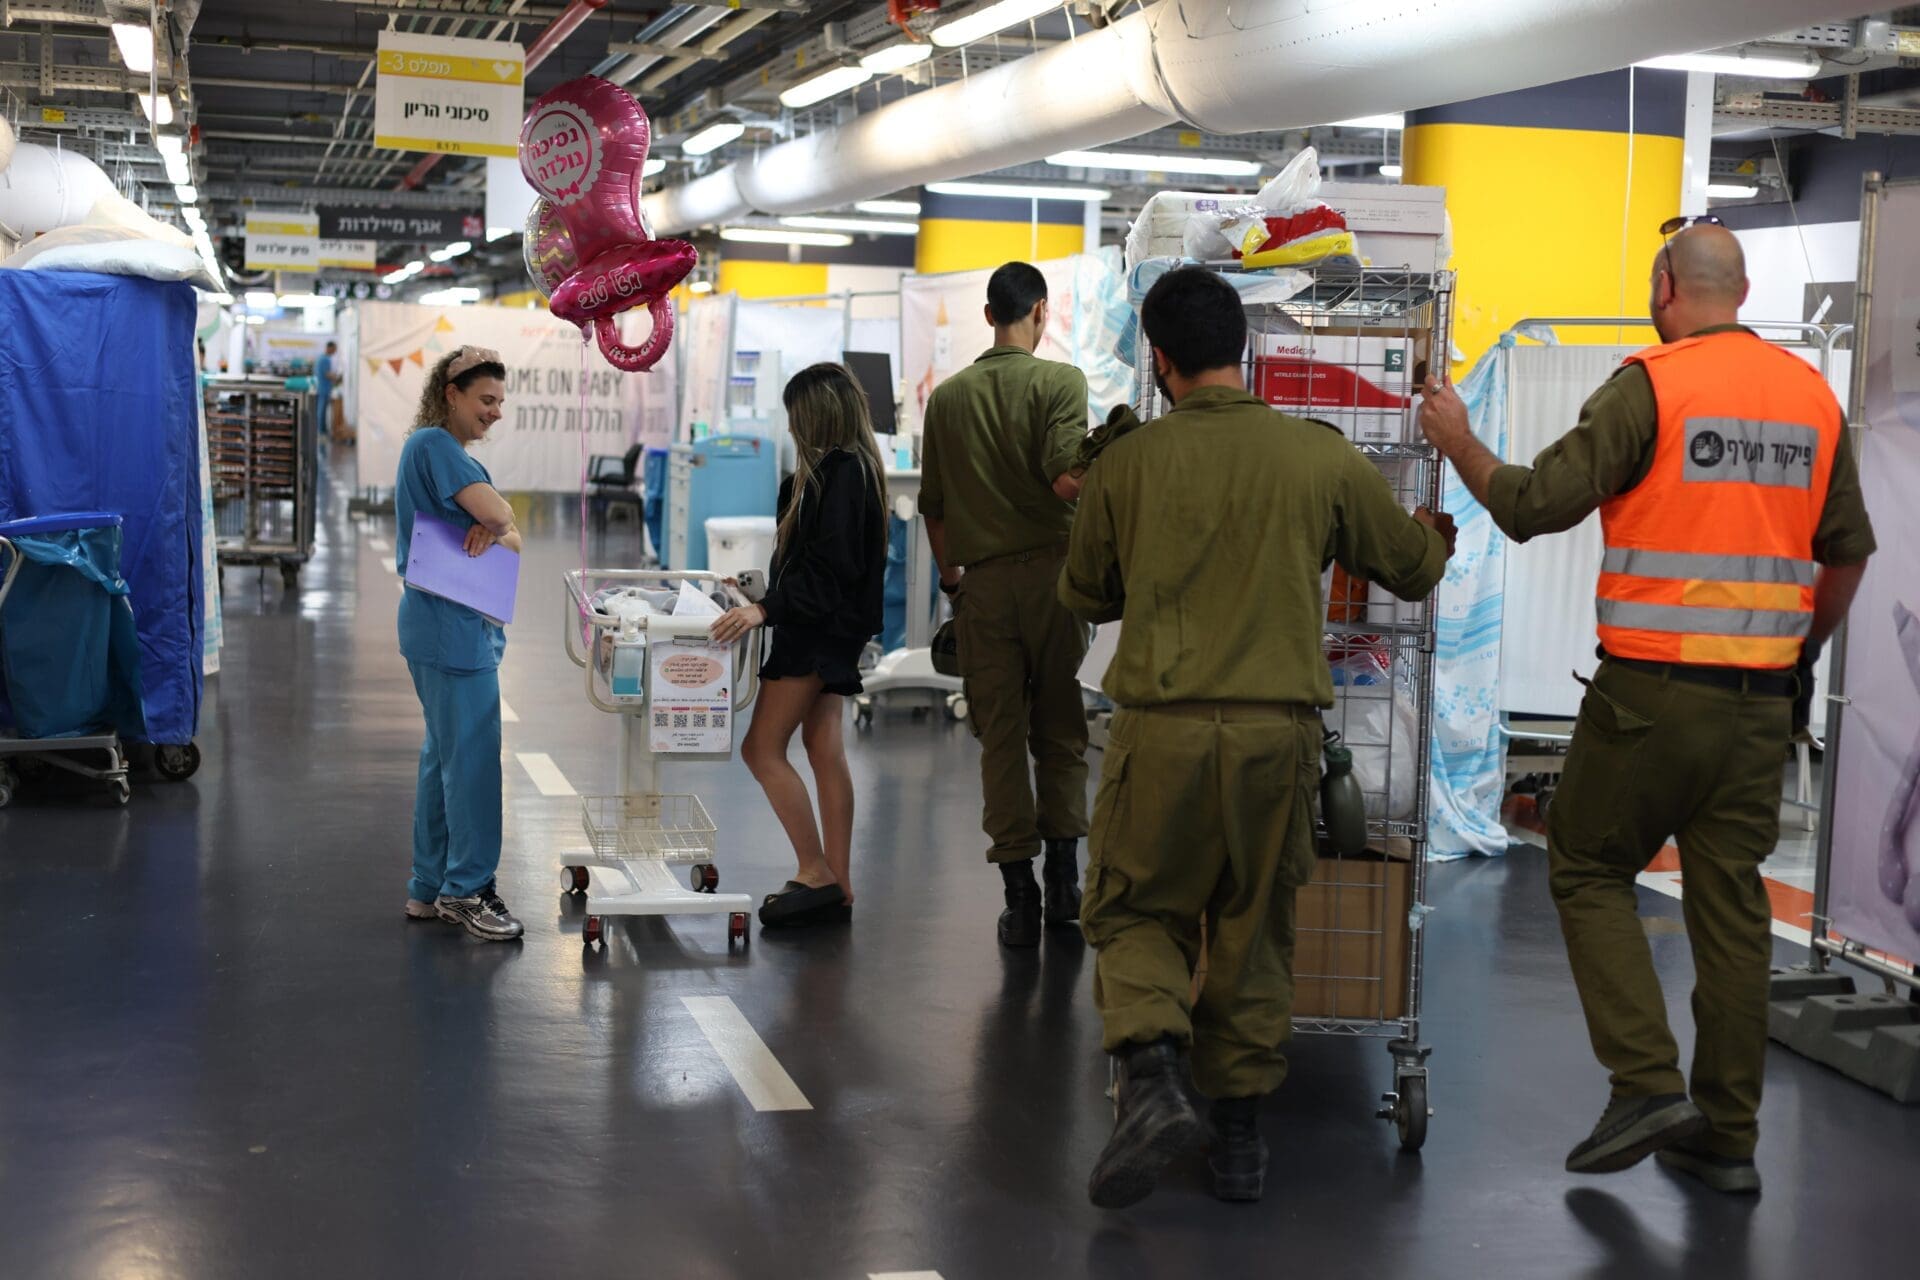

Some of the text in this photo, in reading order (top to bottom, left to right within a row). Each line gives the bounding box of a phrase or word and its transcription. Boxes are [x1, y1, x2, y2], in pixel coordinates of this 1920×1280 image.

[409, 58, 451, 76] מפלס
[404, 102, 489, 121] סיכוני הריון
[528, 127, 579, 161] נסיכה
[538, 150, 585, 182] נולדה
[338, 215, 406, 233] מיילדות
[410, 217, 442, 235] אגף
[578, 268, 642, 310] מזל טוב
[1276, 345, 1316, 355] Medicae
[1391, 354, 1402, 365] S
[504, 367, 539, 394] OME
[547, 369, 573, 395] ON
[578, 370, 624, 397] BABY
[515, 404, 559, 431] ללדת
[1770, 442, 1812, 470] פיקוד
